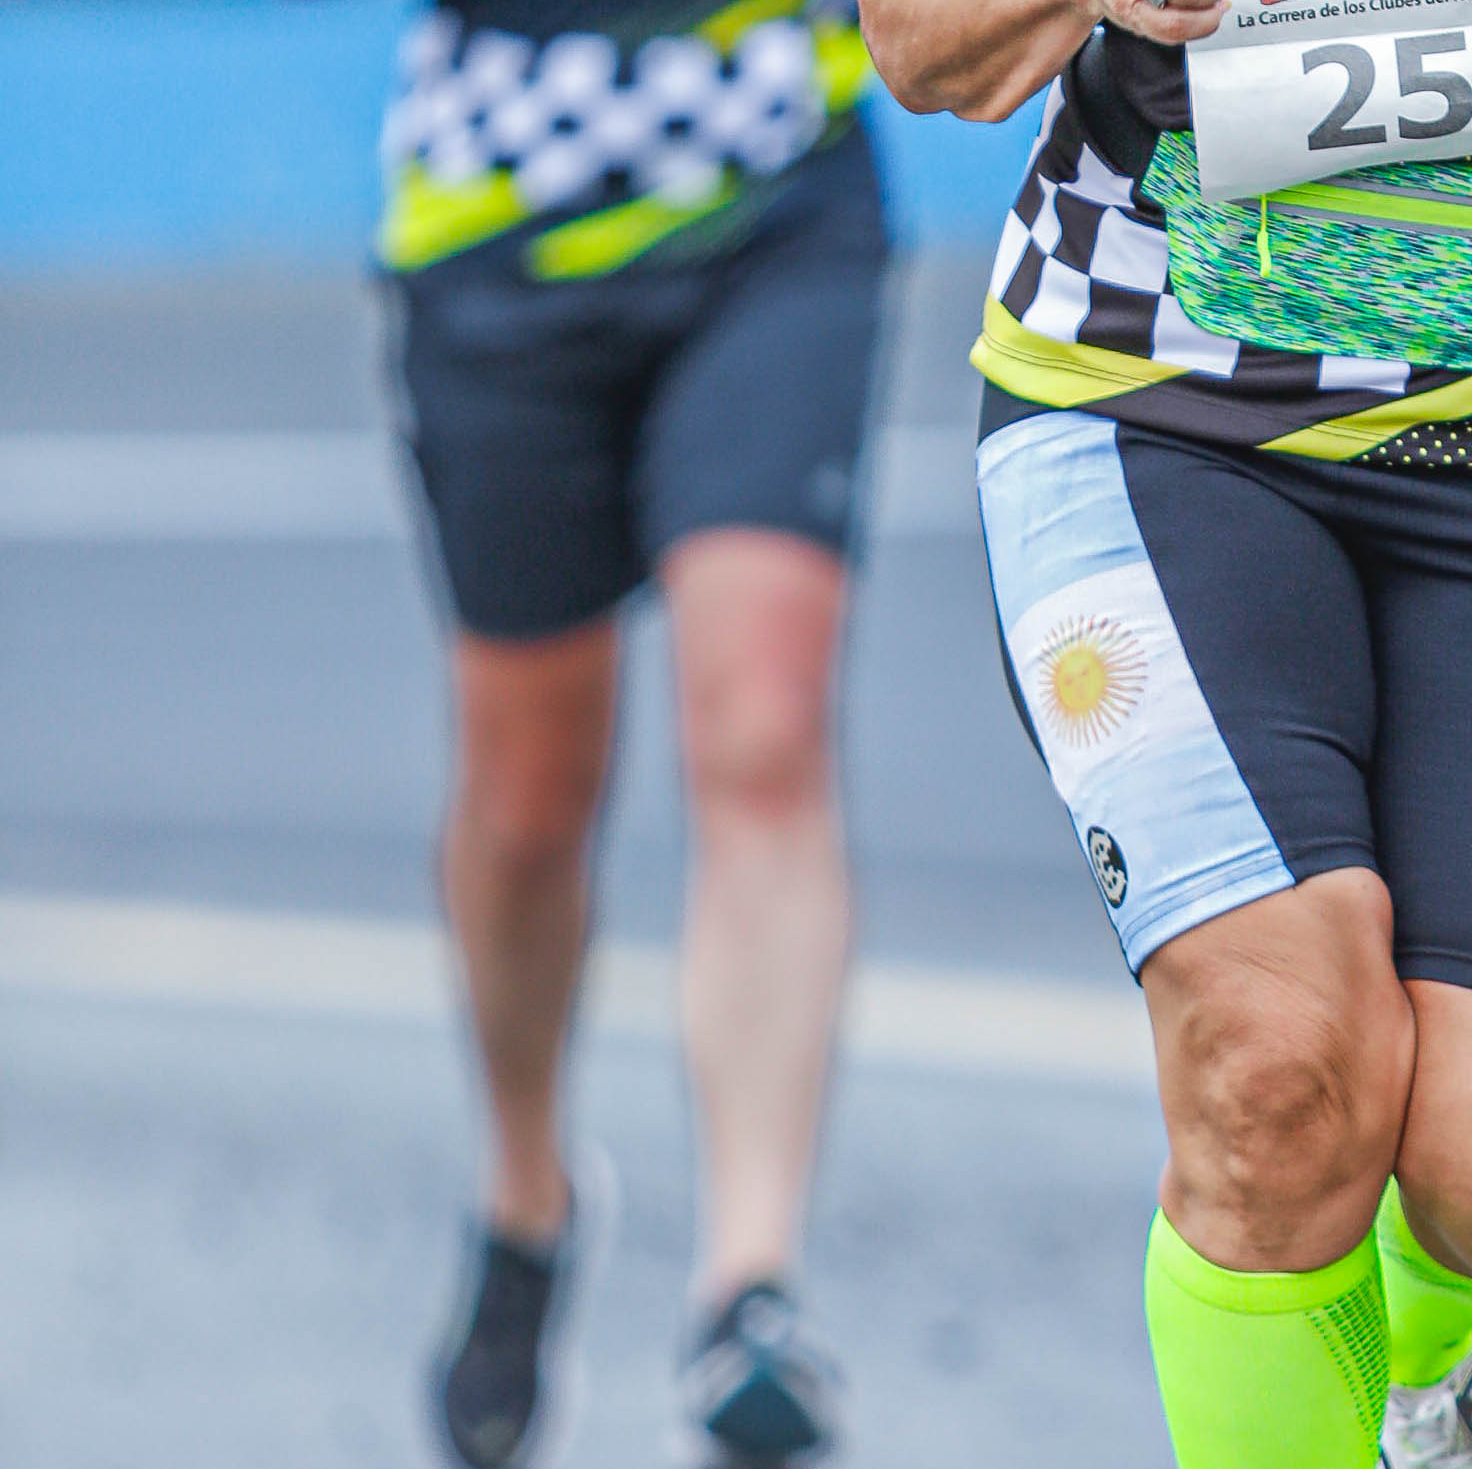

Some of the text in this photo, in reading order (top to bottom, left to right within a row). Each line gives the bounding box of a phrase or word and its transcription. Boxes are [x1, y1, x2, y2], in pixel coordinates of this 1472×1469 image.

[1237, 13, 1256, 28] La
[1258, 7, 1317, 27] Carrera
[1319, 2, 1341, 18] de
[1343, 0, 1366, 15] los
